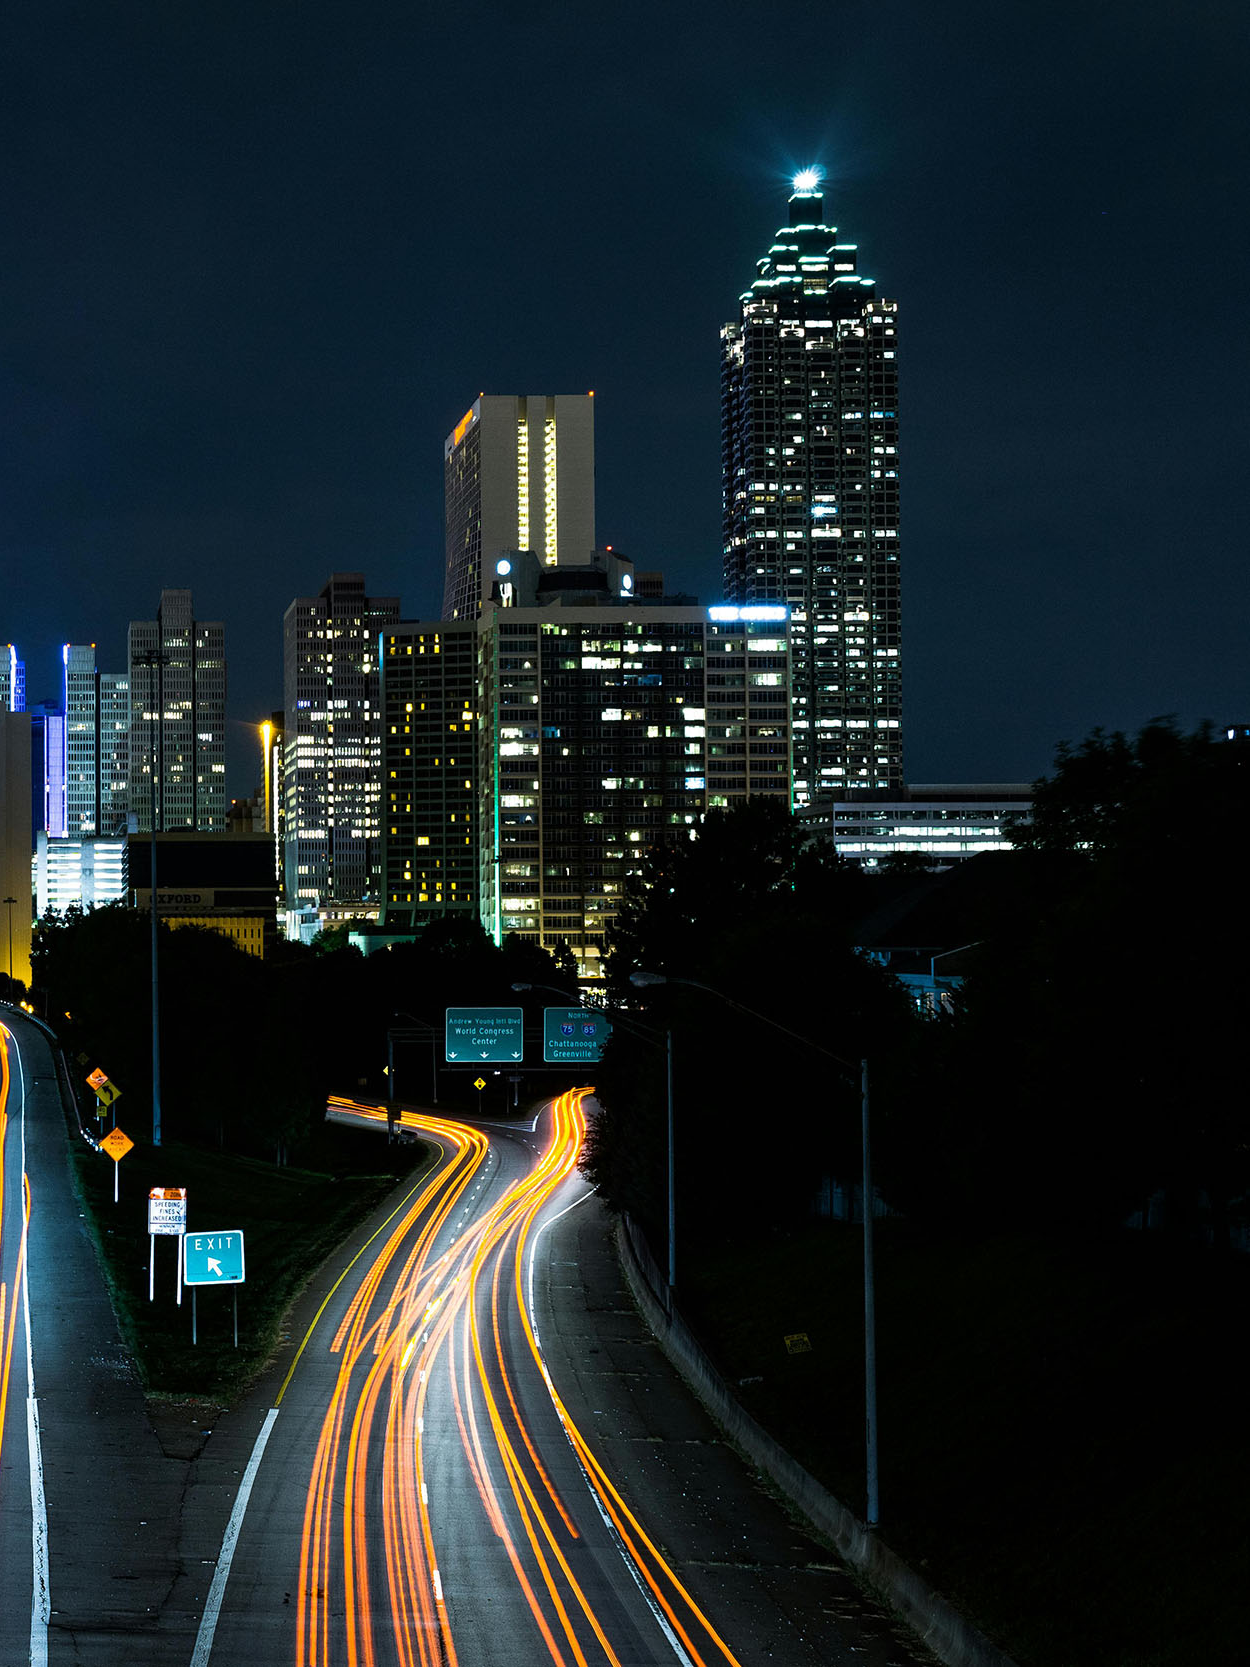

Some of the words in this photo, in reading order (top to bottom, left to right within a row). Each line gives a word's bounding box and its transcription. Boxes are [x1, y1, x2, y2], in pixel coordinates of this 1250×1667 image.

[475, 1018, 494, 1026] Young
[455, 1027, 476, 1035] World
[479, 1027, 514, 1036] Congress
[563, 1025, 573, 1033] 75
[584, 1026, 594, 1034] 85
[548, 1040, 597, 1049] Chattanooga
[553, 1050, 592, 1058] Greenville
[194, 1237, 232, 1251] EXIT
